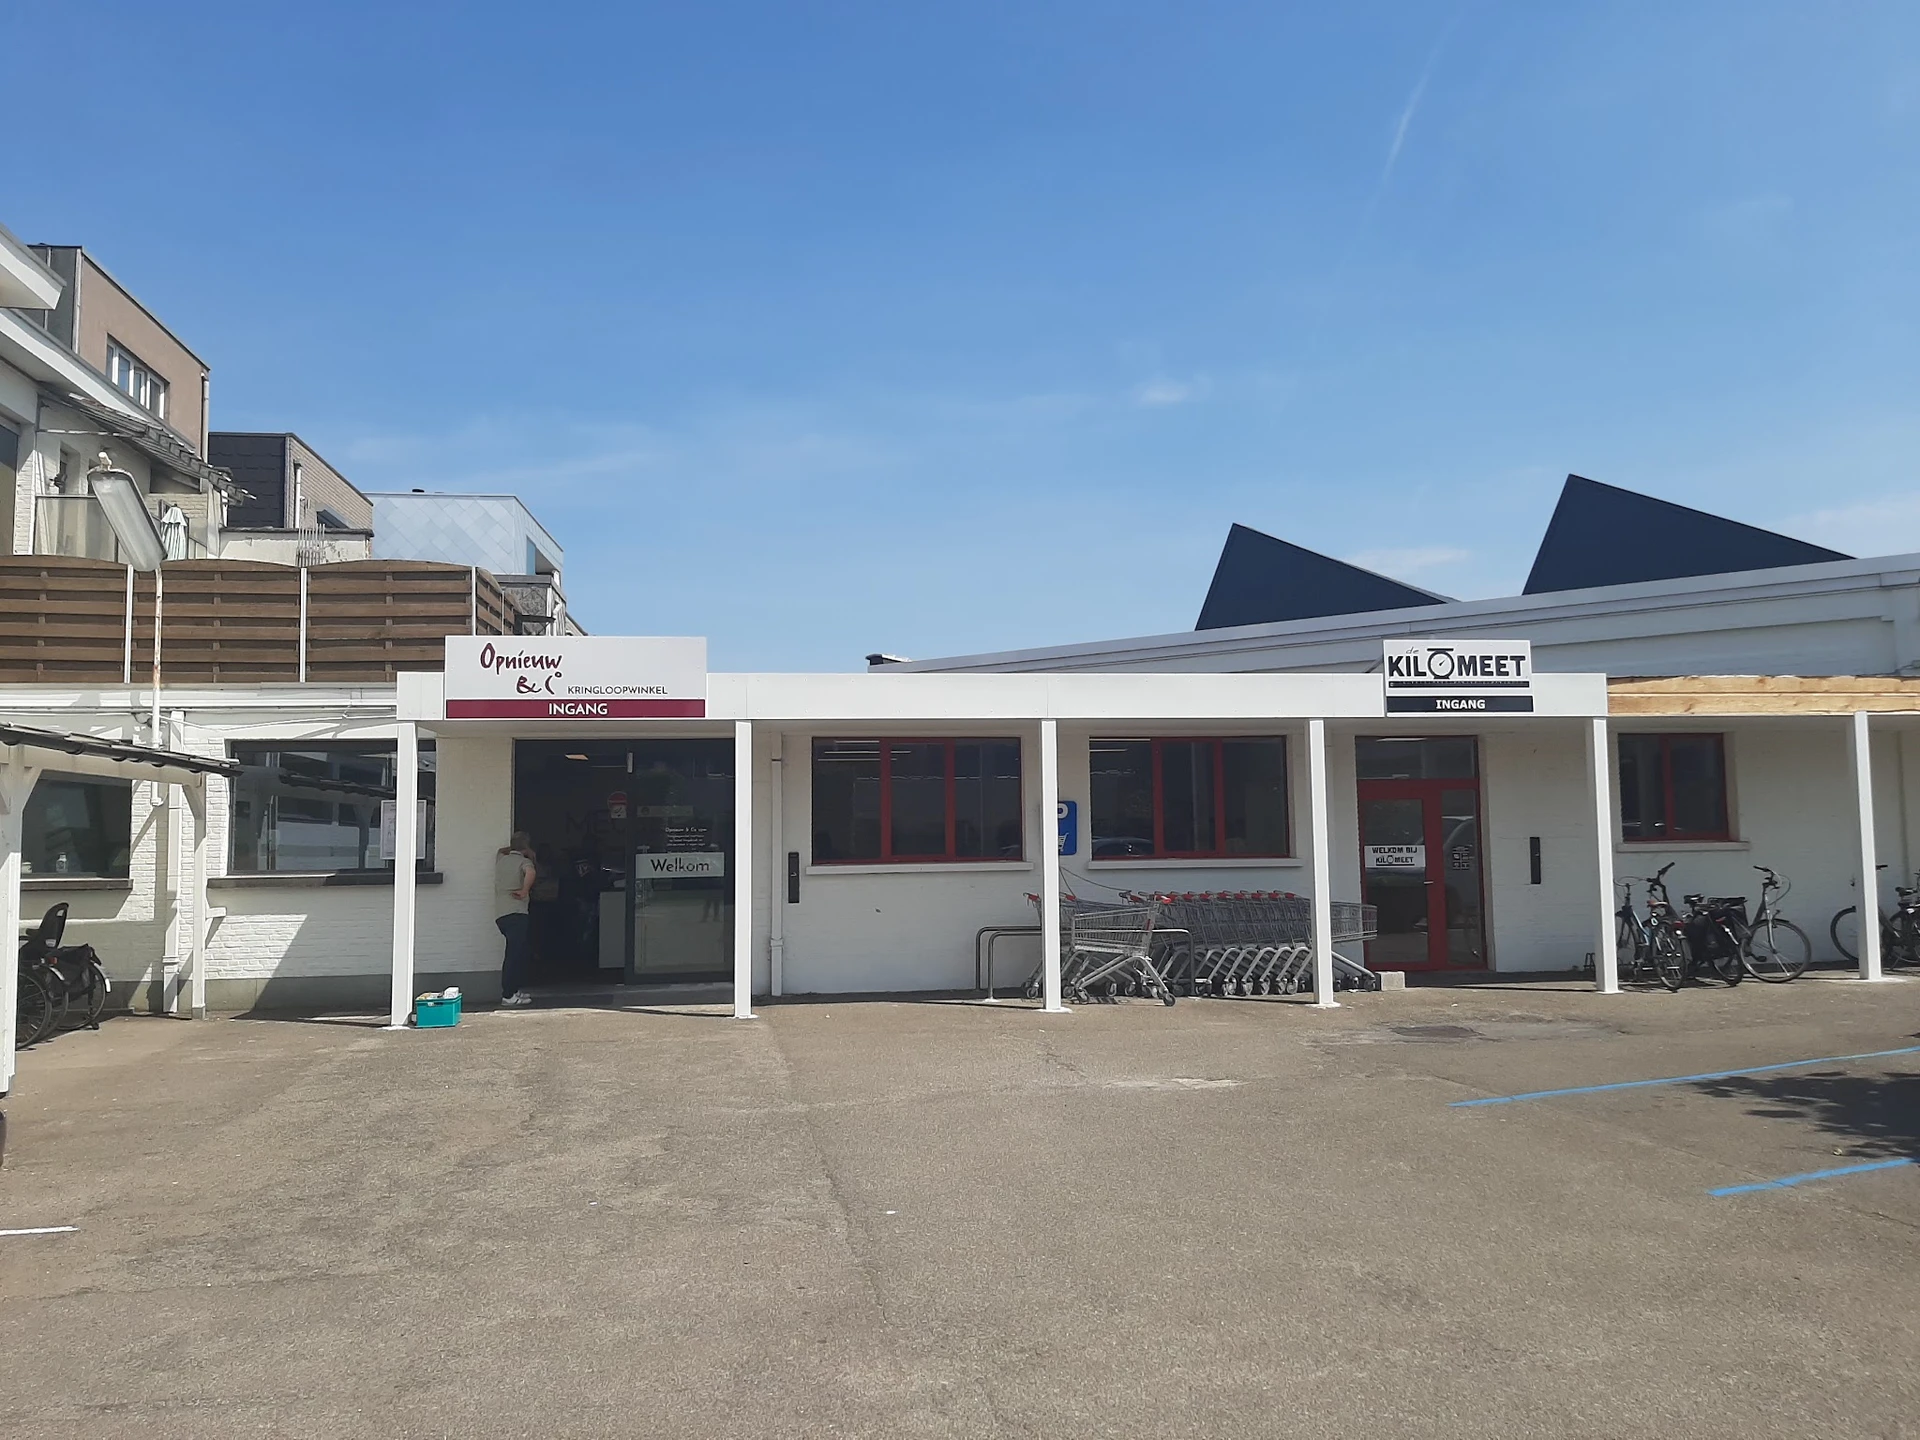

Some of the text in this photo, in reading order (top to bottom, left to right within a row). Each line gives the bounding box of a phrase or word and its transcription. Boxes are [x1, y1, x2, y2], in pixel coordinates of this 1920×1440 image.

[1405, 646, 1420, 655] de
[480, 642, 563, 675] Opnieuw
[567, 685, 668, 695] KRINGLOOPWINKEL
[549, 702, 608, 715] INGANG
[1435, 699, 1486, 710] INGANG
[1371, 846, 1404, 854] WELKOM
[650, 857, 709, 872] Welkom
